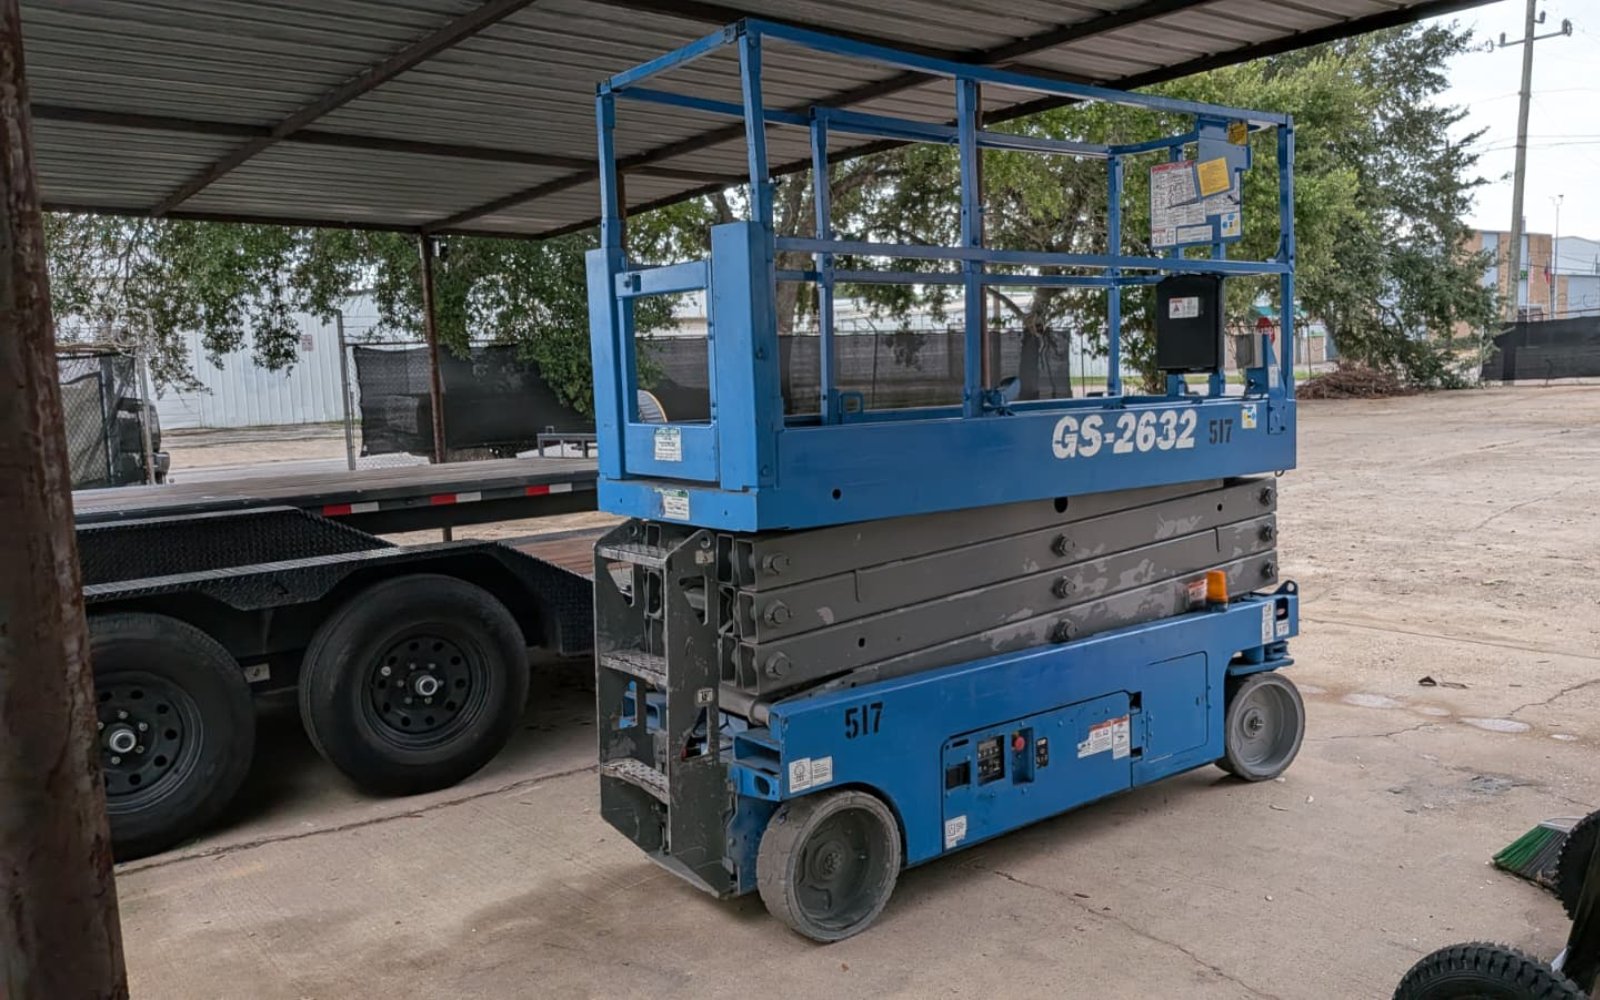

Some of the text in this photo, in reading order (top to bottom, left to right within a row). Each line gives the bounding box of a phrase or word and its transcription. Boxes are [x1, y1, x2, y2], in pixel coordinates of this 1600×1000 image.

[1052, 409, 1197, 459] GS-2632
[1209, 419, 1233, 445] 517
[845, 702, 883, 739] 517
